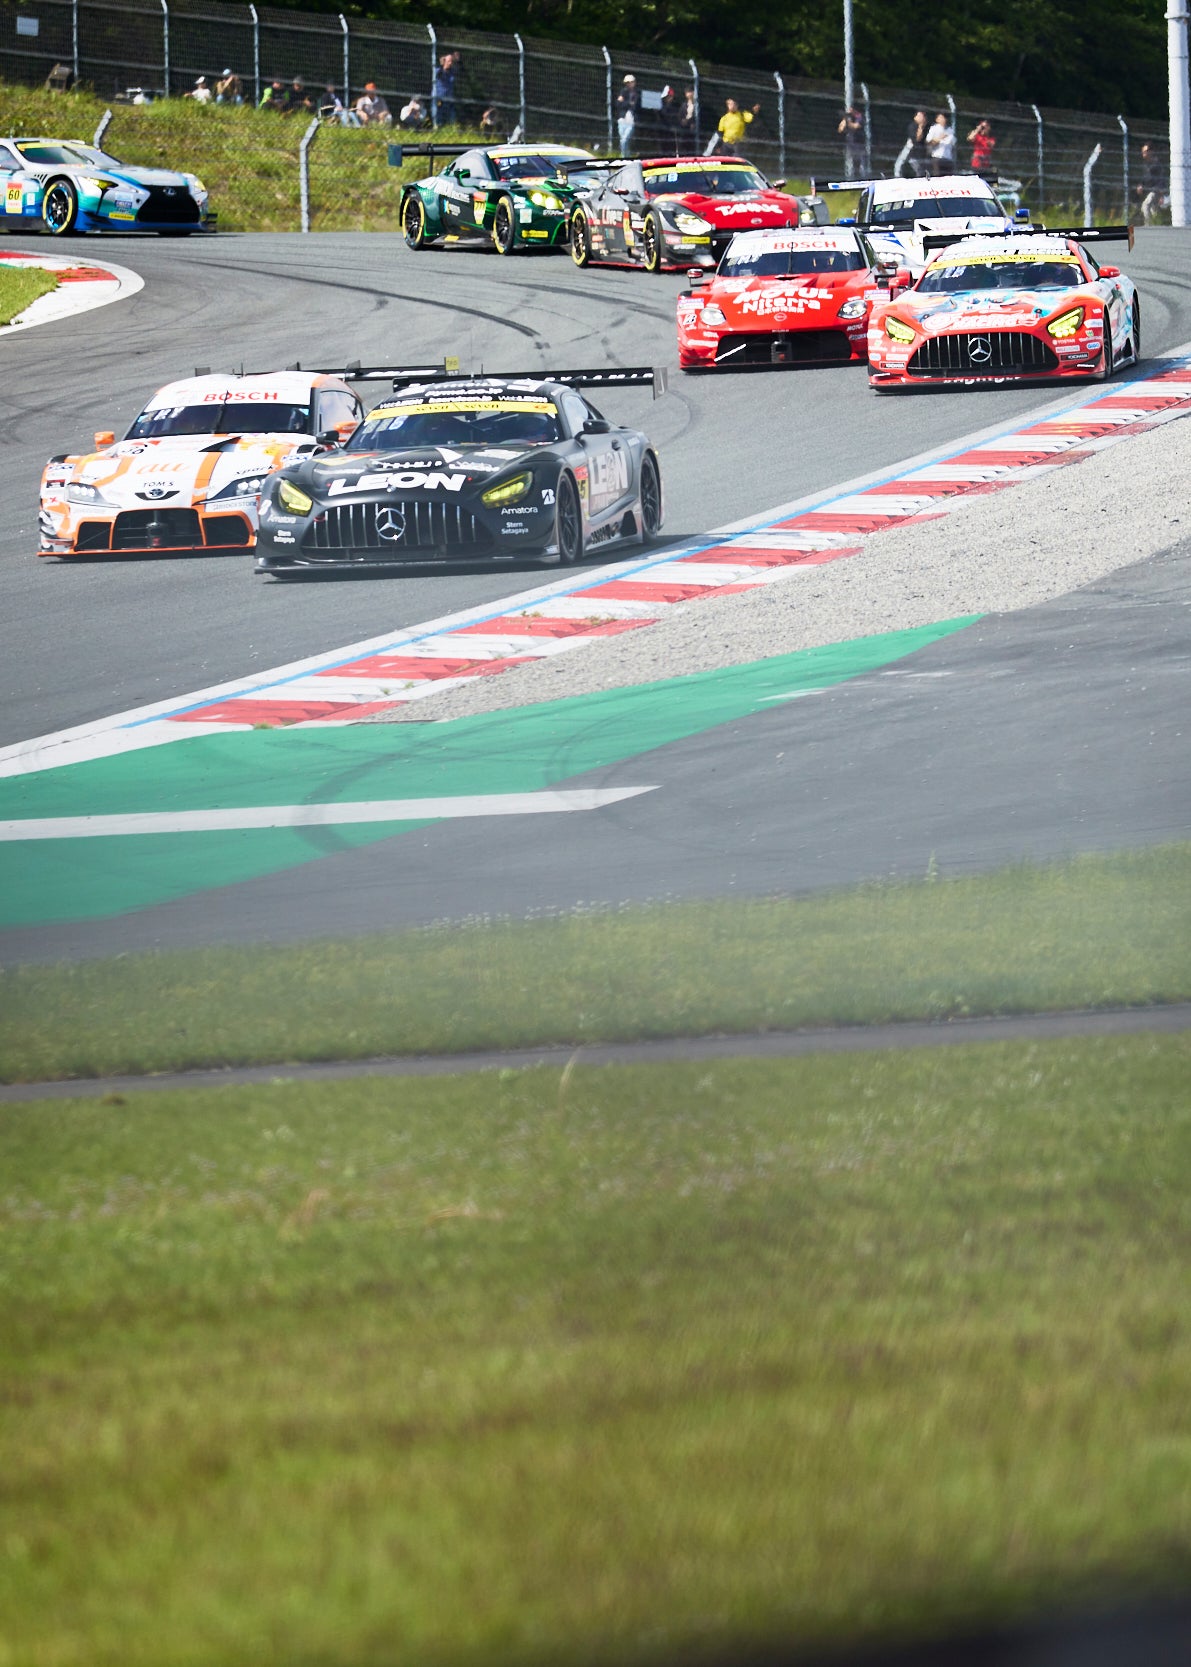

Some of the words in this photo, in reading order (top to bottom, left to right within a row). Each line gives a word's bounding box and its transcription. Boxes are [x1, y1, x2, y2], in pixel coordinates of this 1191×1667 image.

[8, 189, 20, 200] 60
[918, 189, 971, 197] BOSCH
[773, 241, 838, 250] BOSCH
[733, 287, 834, 304] MOTUL
[743, 297, 821, 313] Niterra
[203, 392, 278, 402] BOSCH
[327, 472, 466, 497] LEON
[500, 506, 538, 515] Amatora
